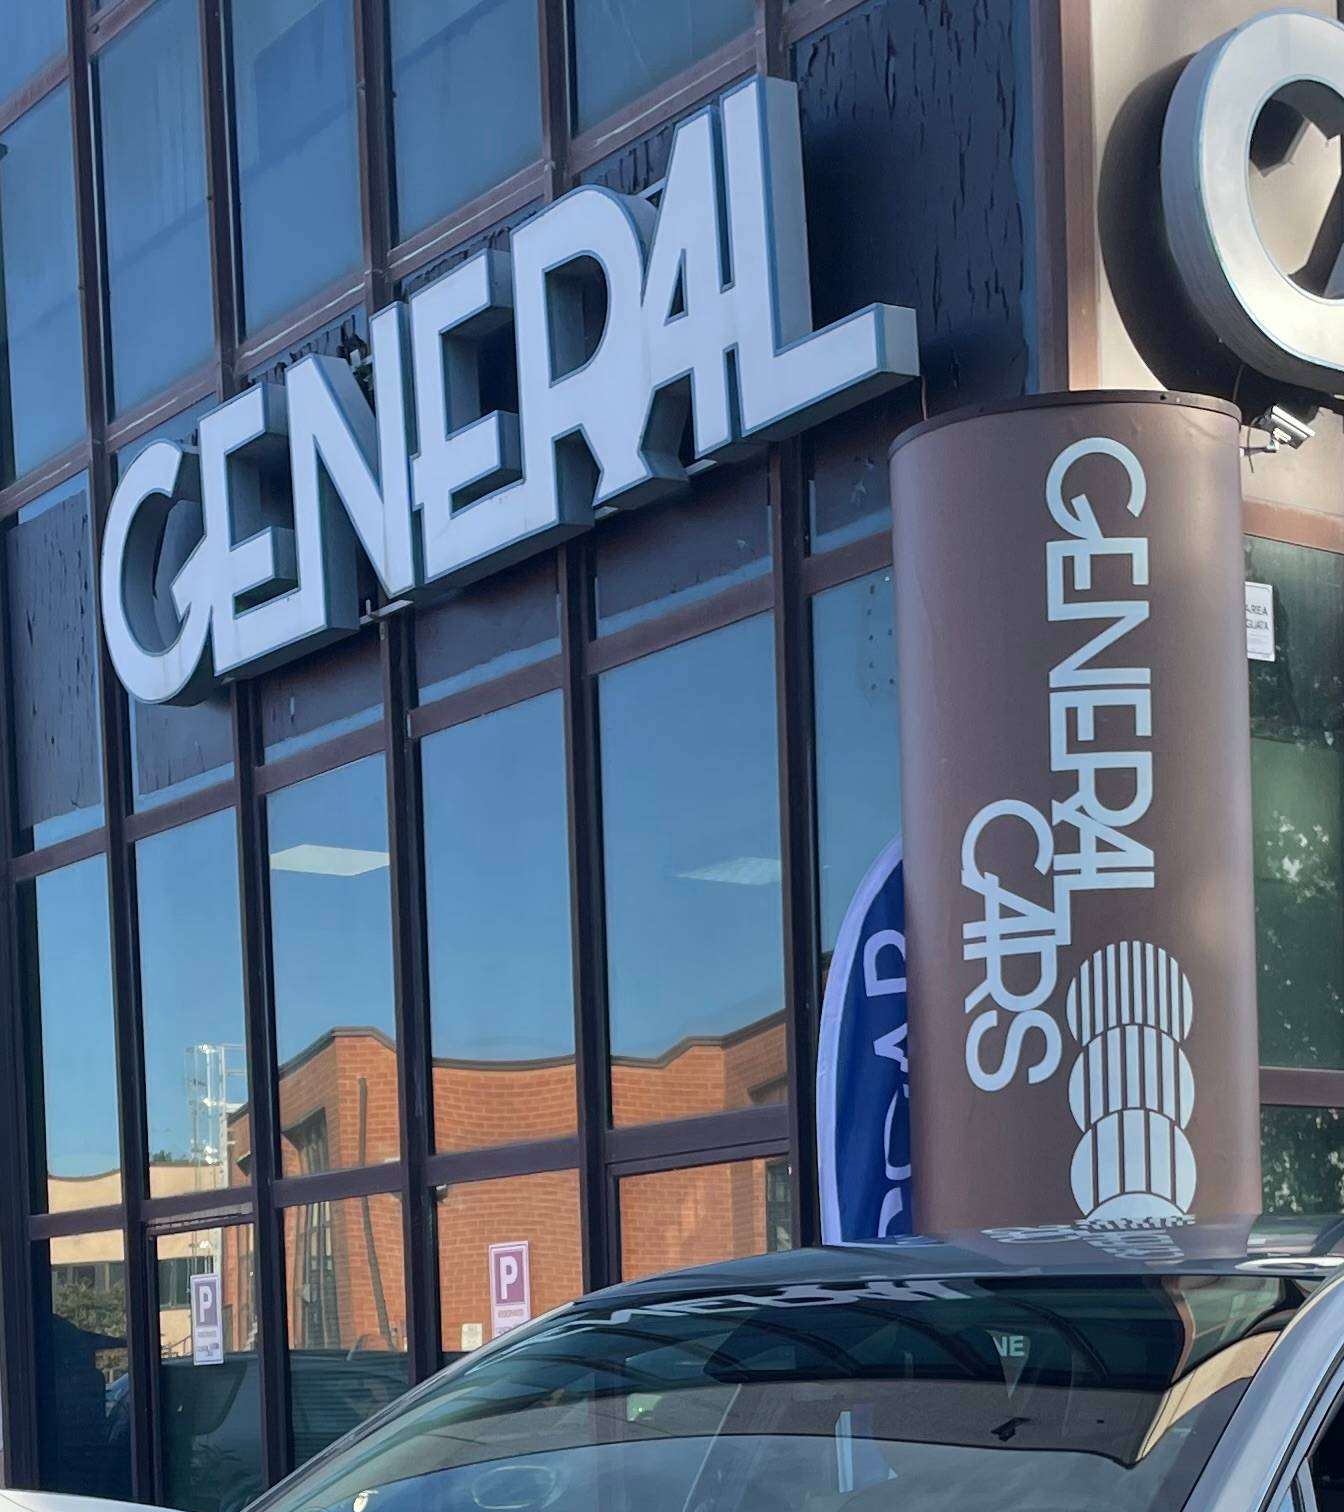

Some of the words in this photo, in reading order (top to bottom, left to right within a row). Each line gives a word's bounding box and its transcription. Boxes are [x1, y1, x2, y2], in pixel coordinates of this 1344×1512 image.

[100, 73, 919, 707] GENERAL
[1045, 436, 1155, 946] GENERAL
[960, 798, 1064, 1093] CARS
[199, 1285, 213, 1323] P
[500, 1255, 518, 1300] P
